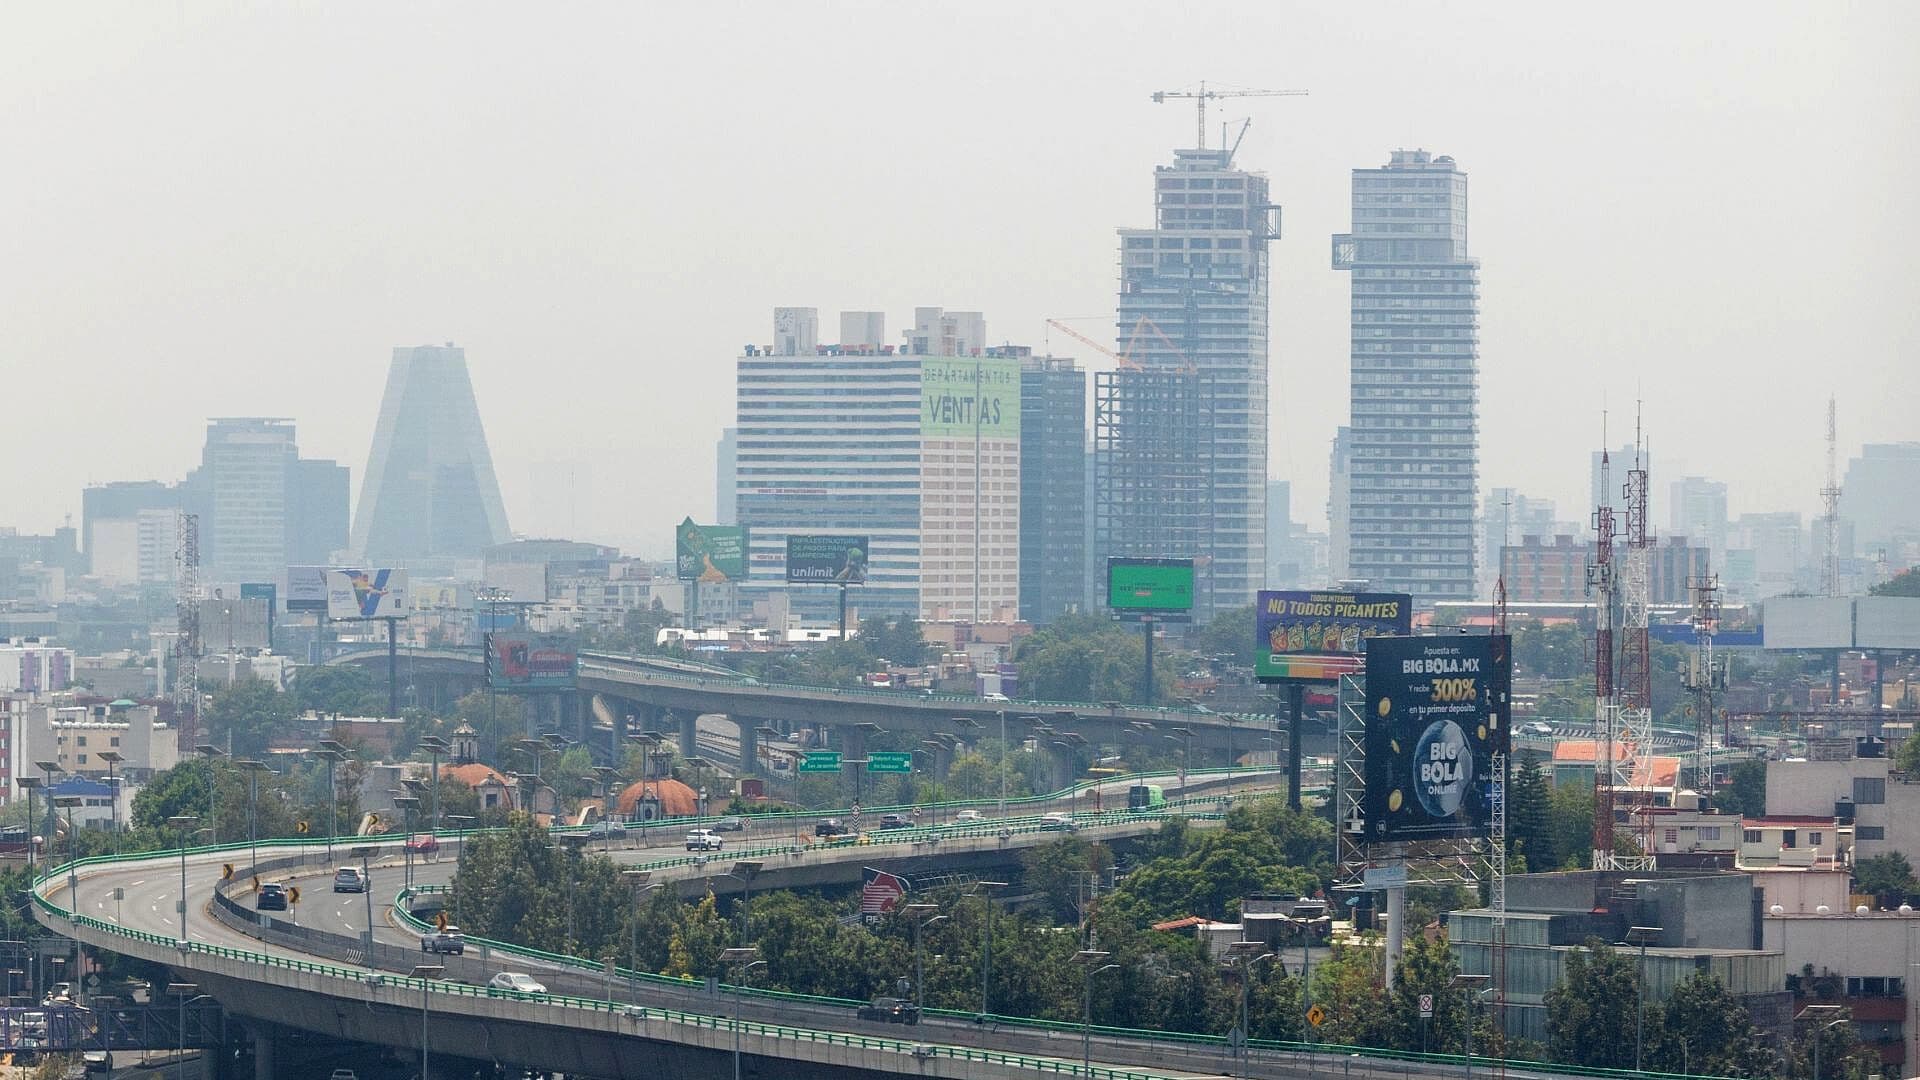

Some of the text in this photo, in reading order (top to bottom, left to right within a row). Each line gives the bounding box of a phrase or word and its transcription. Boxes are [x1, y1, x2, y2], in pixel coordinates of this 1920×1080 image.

[925, 368, 1010, 384] DEPARTAMENTOS
[929, 395, 1000, 425] VENTAS
[792, 566, 834, 577] unlimit
[1268, 599, 1399, 618] NO TODOS PICANTES
[1424, 646, 1449, 656] Apuesta
[1403, 658, 1479, 674] BIG BOLA.MX
[1431, 678, 1476, 701] 300%
[1418, 705, 1426, 713] tu
[1426, 704, 1448, 715] primer
[1431, 742, 1457, 760] BIG
[1421, 761, 1464, 783] BOLA
[1428, 785, 1457, 795] ONLINE
